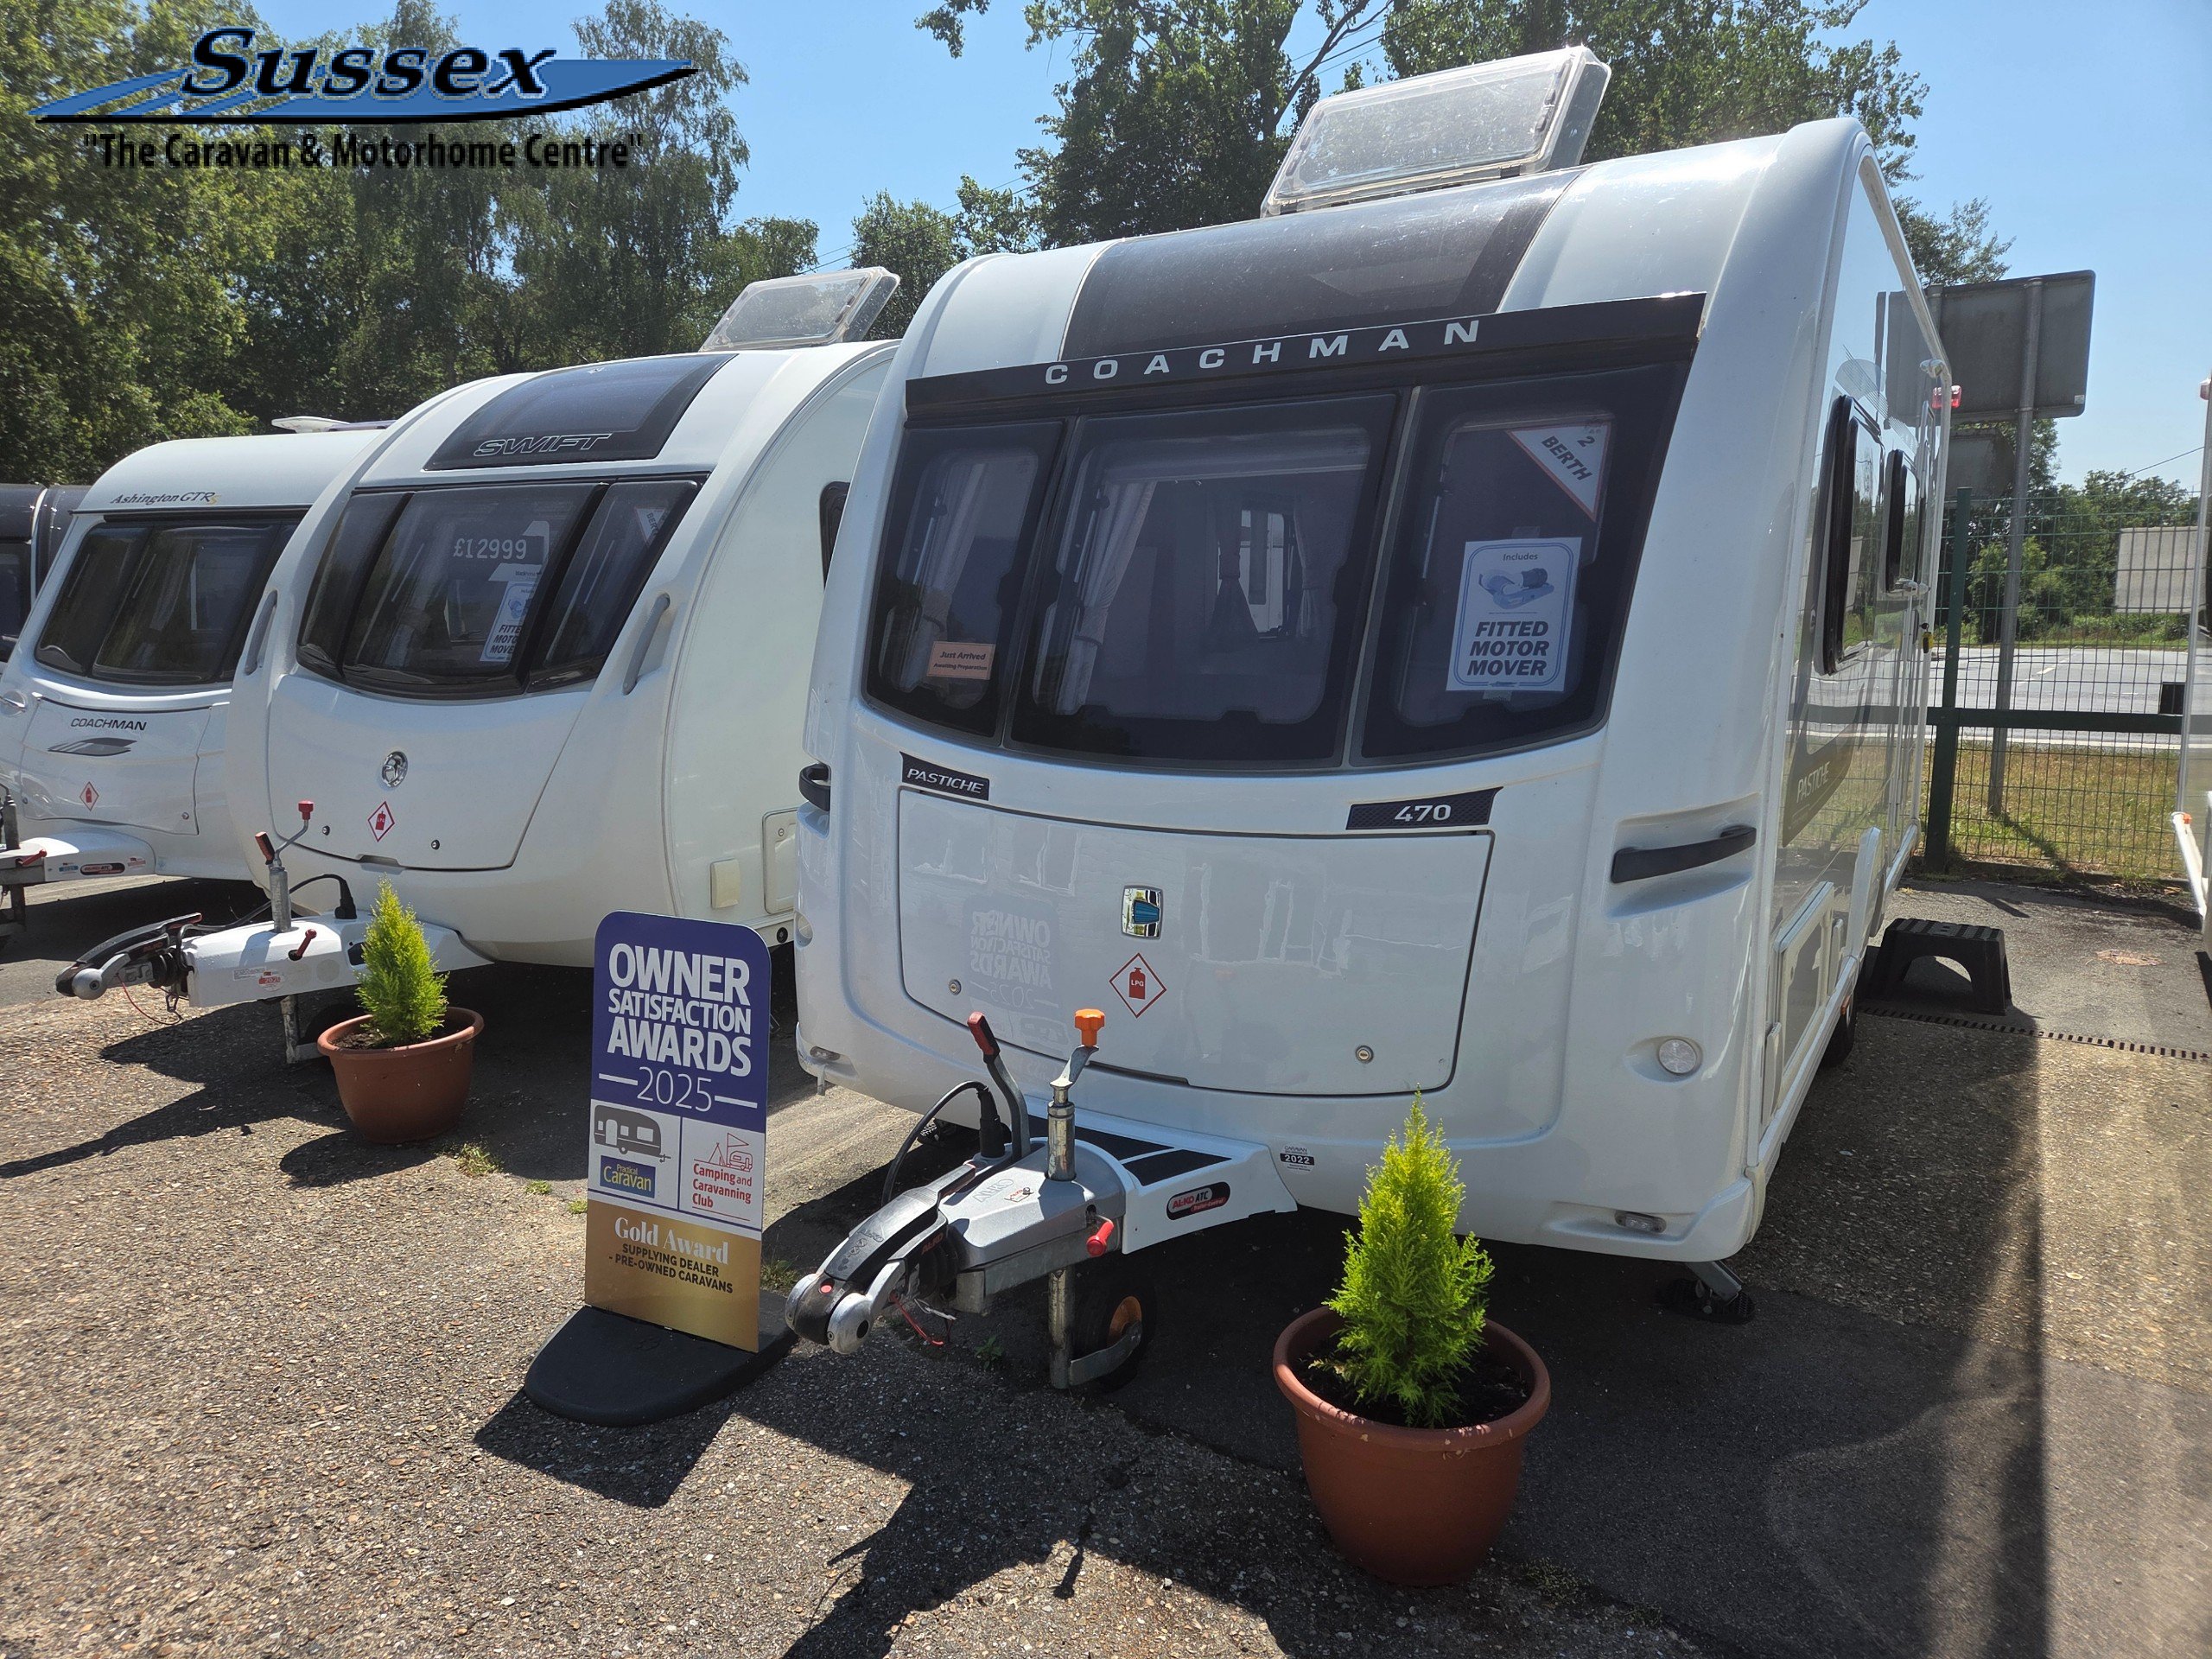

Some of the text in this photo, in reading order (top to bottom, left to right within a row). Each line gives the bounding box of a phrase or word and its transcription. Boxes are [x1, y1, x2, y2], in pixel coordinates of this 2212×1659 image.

[1045, 320, 1479, 385] COACHMAN
[474, 433, 612, 457] SWIFT
[1577, 435, 1595, 448] 2
[1541, 435, 1592, 481] BERTH
[111, 493, 180, 505] Ashington
[453, 538, 527, 560] £12999
[1503, 552, 1539, 561] Includes
[1475, 620, 1549, 637] FITTED
[1470, 640, 1550, 657] MOTOR
[1467, 660, 1547, 676] MOVER
[70, 718, 147, 731] COACHMAN
[906, 768, 984, 794] PASTICHE
[1796, 761, 1830, 803] PASTICHE
[1395, 804, 1451, 822] 470
[609, 943, 751, 1006] OWNER
[608, 988, 751, 1034] SATISFACTION
[607, 1016, 752, 1077] AWARDS
[637, 1066, 712, 1112] 2025
[617, 1164, 639, 1175] Practical
[1285, 1154, 1310, 1164] 2022
[603, 1166, 652, 1192] Caravan
[694, 1164, 752, 1186] Camping and
[693, 1179, 752, 1205] Caravanning
[693, 1192, 714, 1208] Club
[1173, 1191, 1209, 1209] AL-KO ATC
[614, 1217, 728, 1265] Gold Award
[622, 1243, 719, 1278] SUPPLYING DEALER
[615, 1254, 677, 1279] PRE-OWNED
[679, 1270, 733, 1294] CARAVANS
